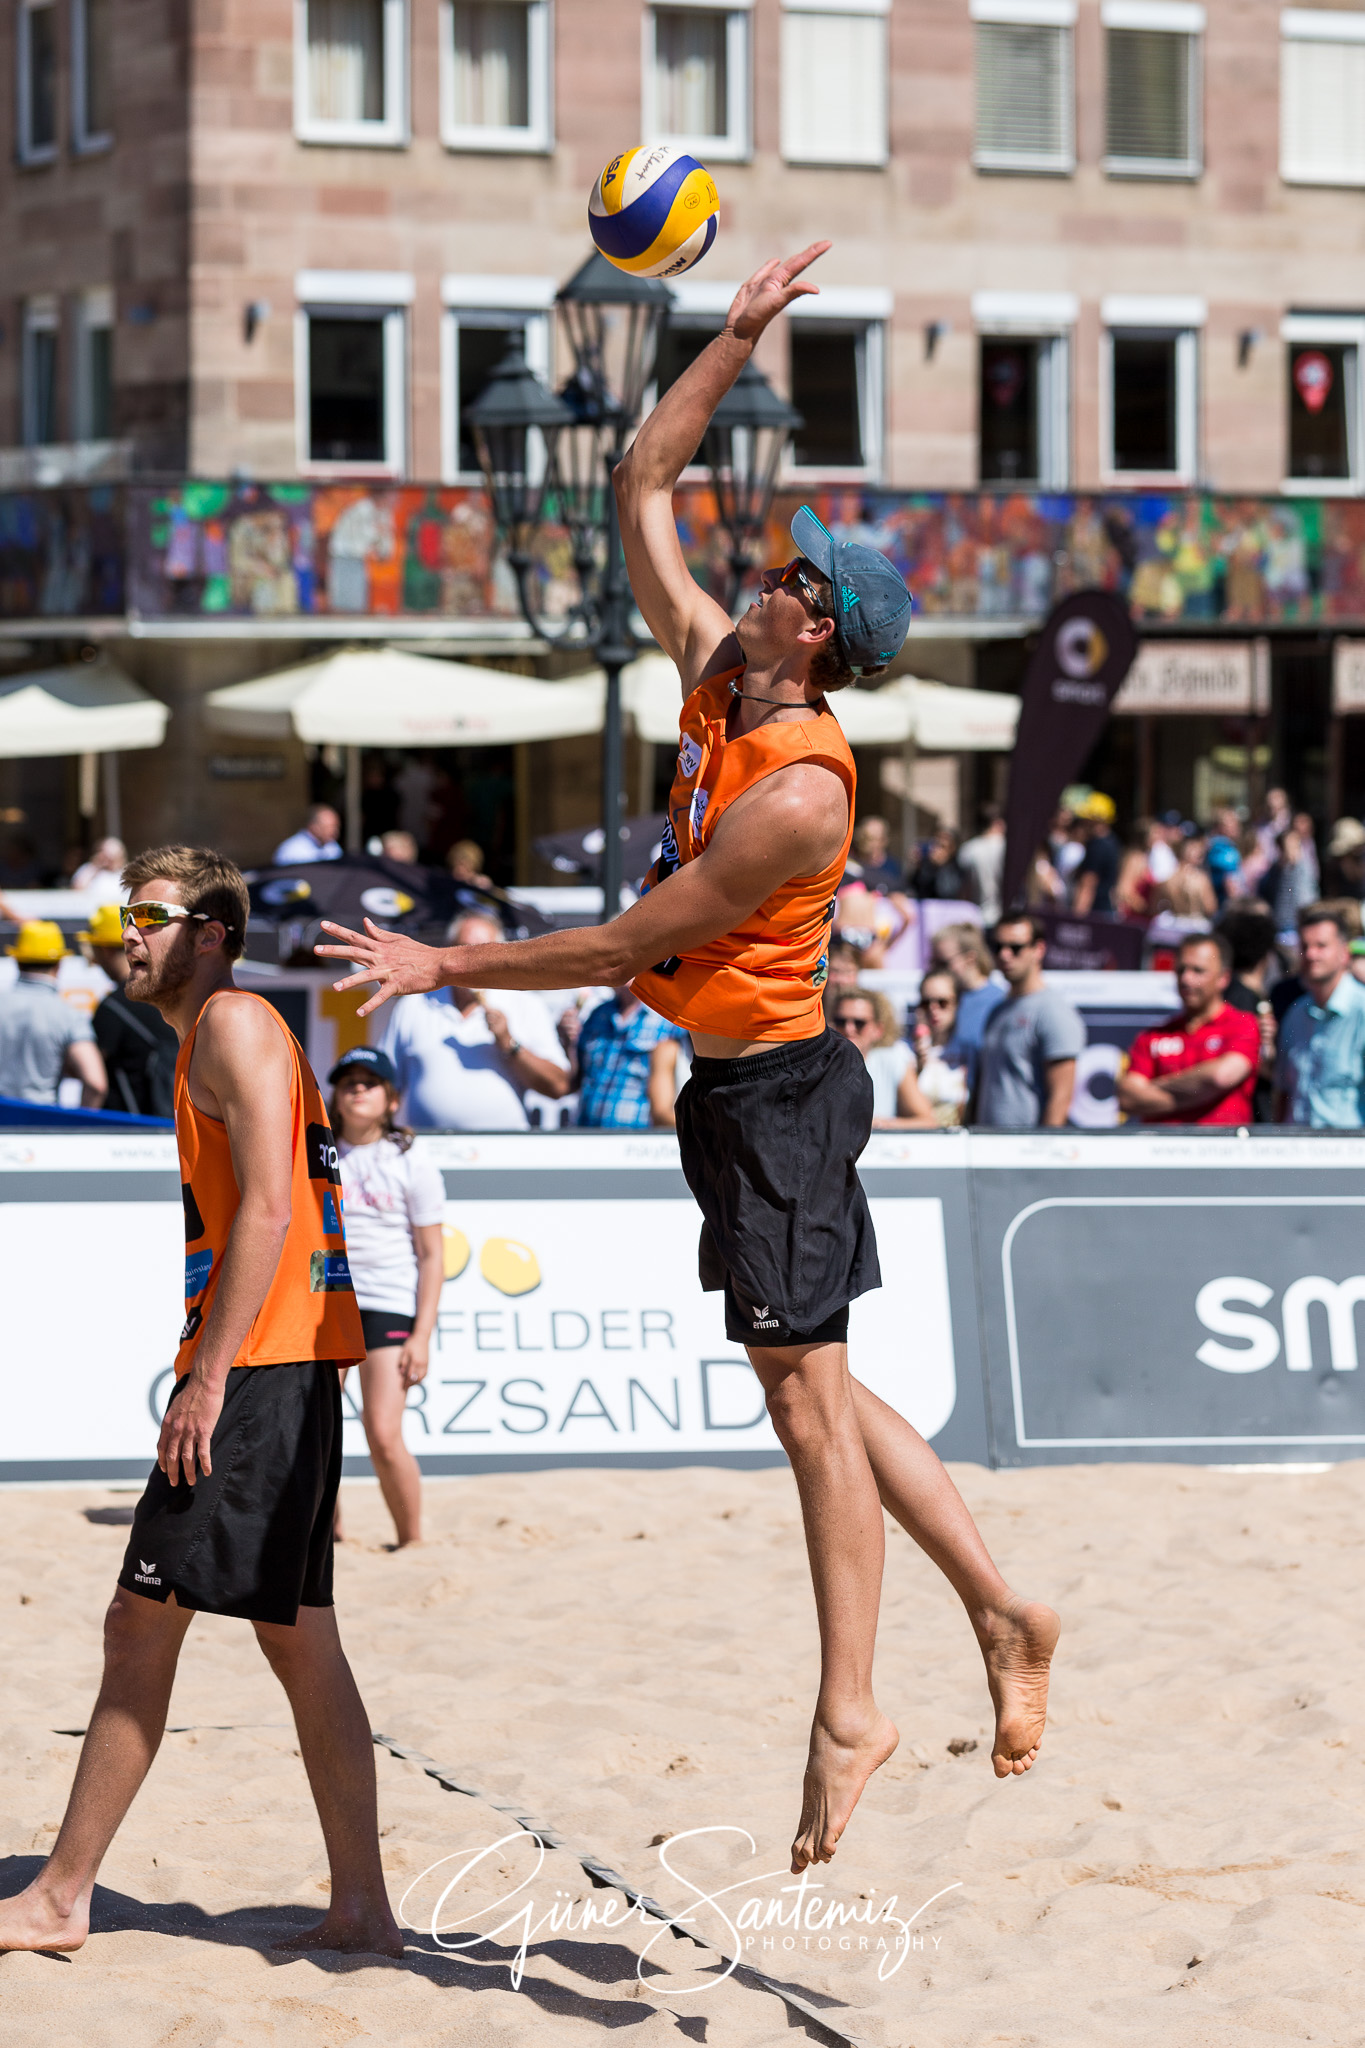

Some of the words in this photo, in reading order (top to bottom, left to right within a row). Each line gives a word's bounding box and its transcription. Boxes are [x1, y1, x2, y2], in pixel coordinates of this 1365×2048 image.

[841, 585, 850, 613] adidas
[752, 1319, 779, 1329] erima
[134, 1573, 161, 1586] erima
